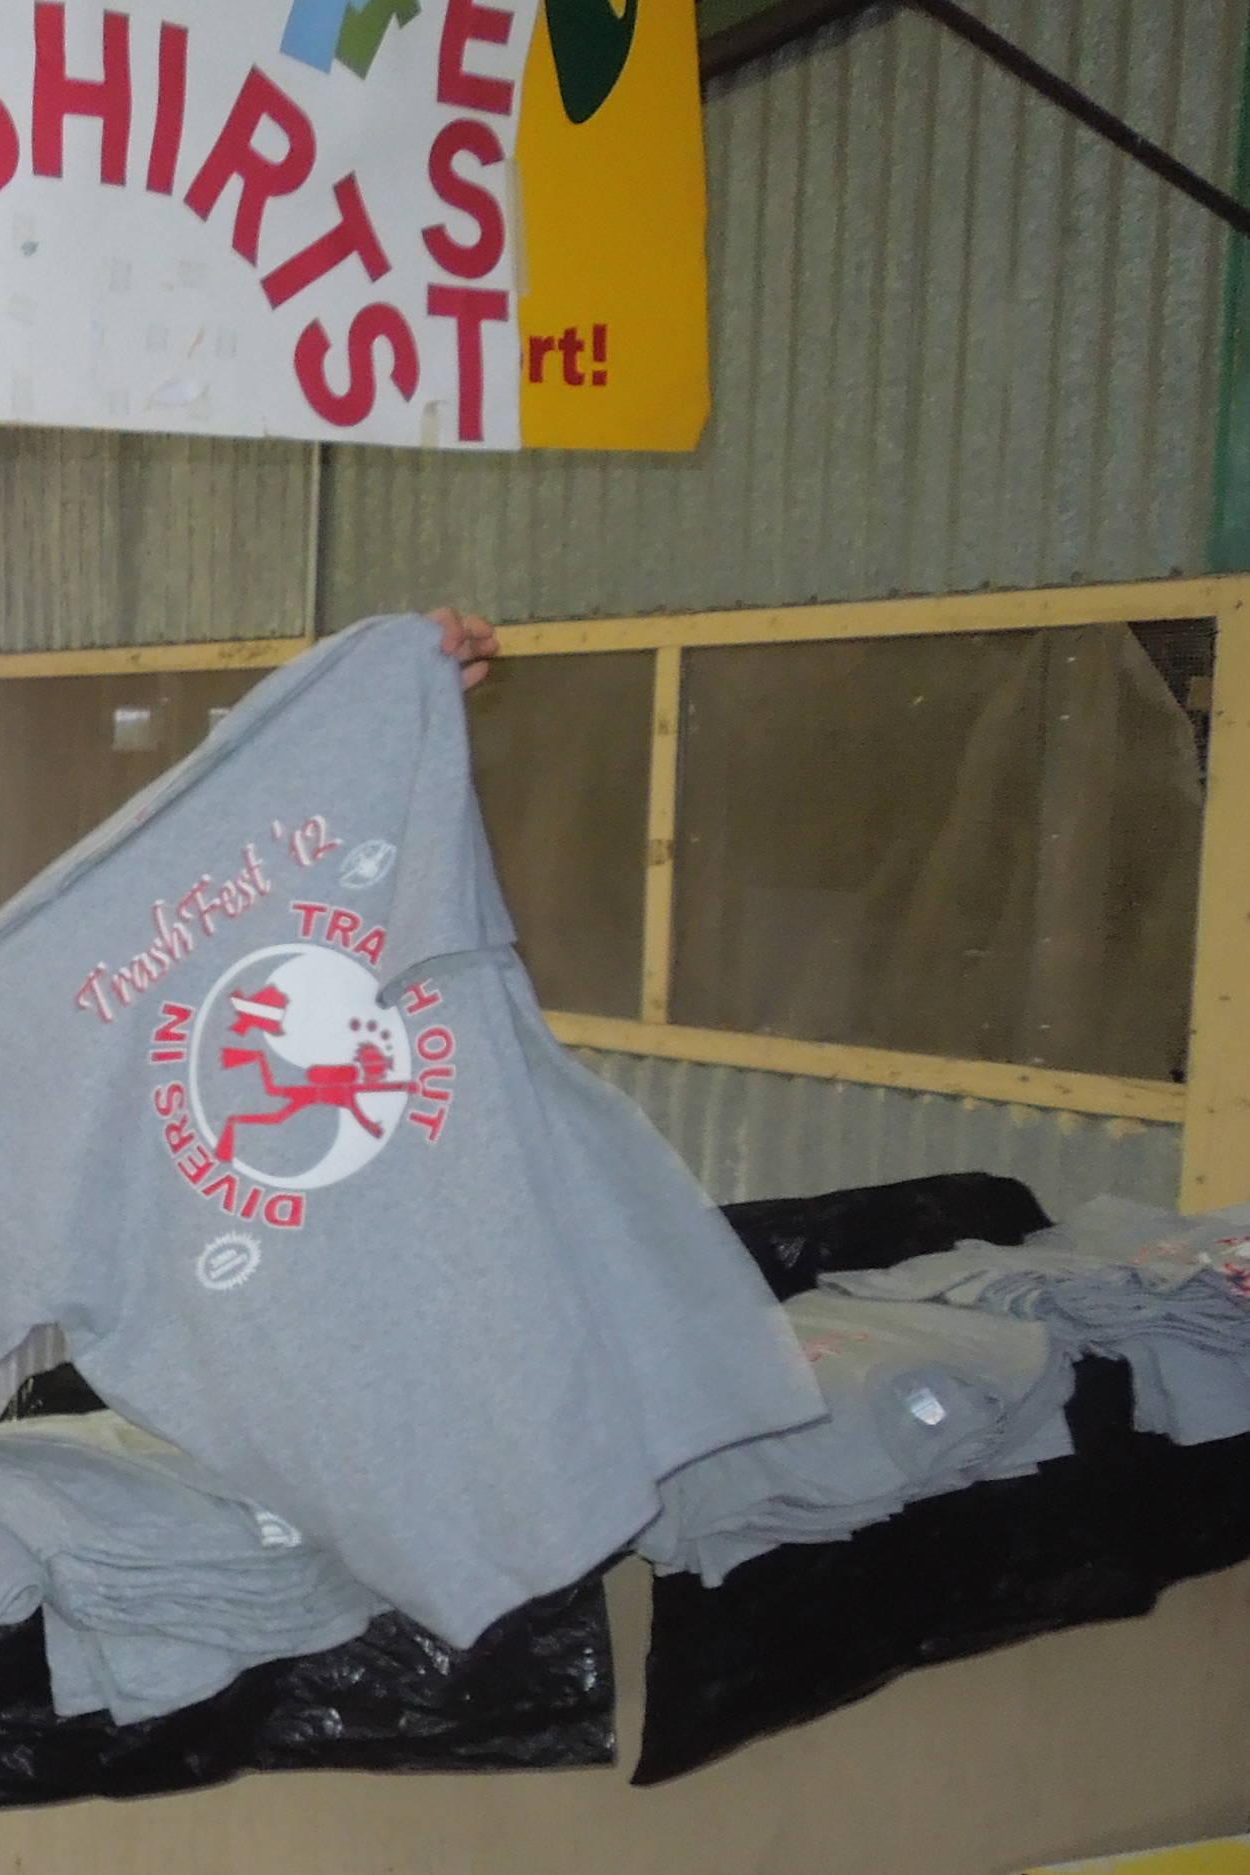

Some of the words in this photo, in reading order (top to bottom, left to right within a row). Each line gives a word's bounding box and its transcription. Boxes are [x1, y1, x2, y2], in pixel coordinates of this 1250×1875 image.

[528, 323, 607, 386] rt!
[290, 900, 443, 1015] TRAH
[150, 1002, 194, 1063] IN
[408, 1025, 456, 1144] OUT
[153, 1081, 307, 1230] DIVERS
